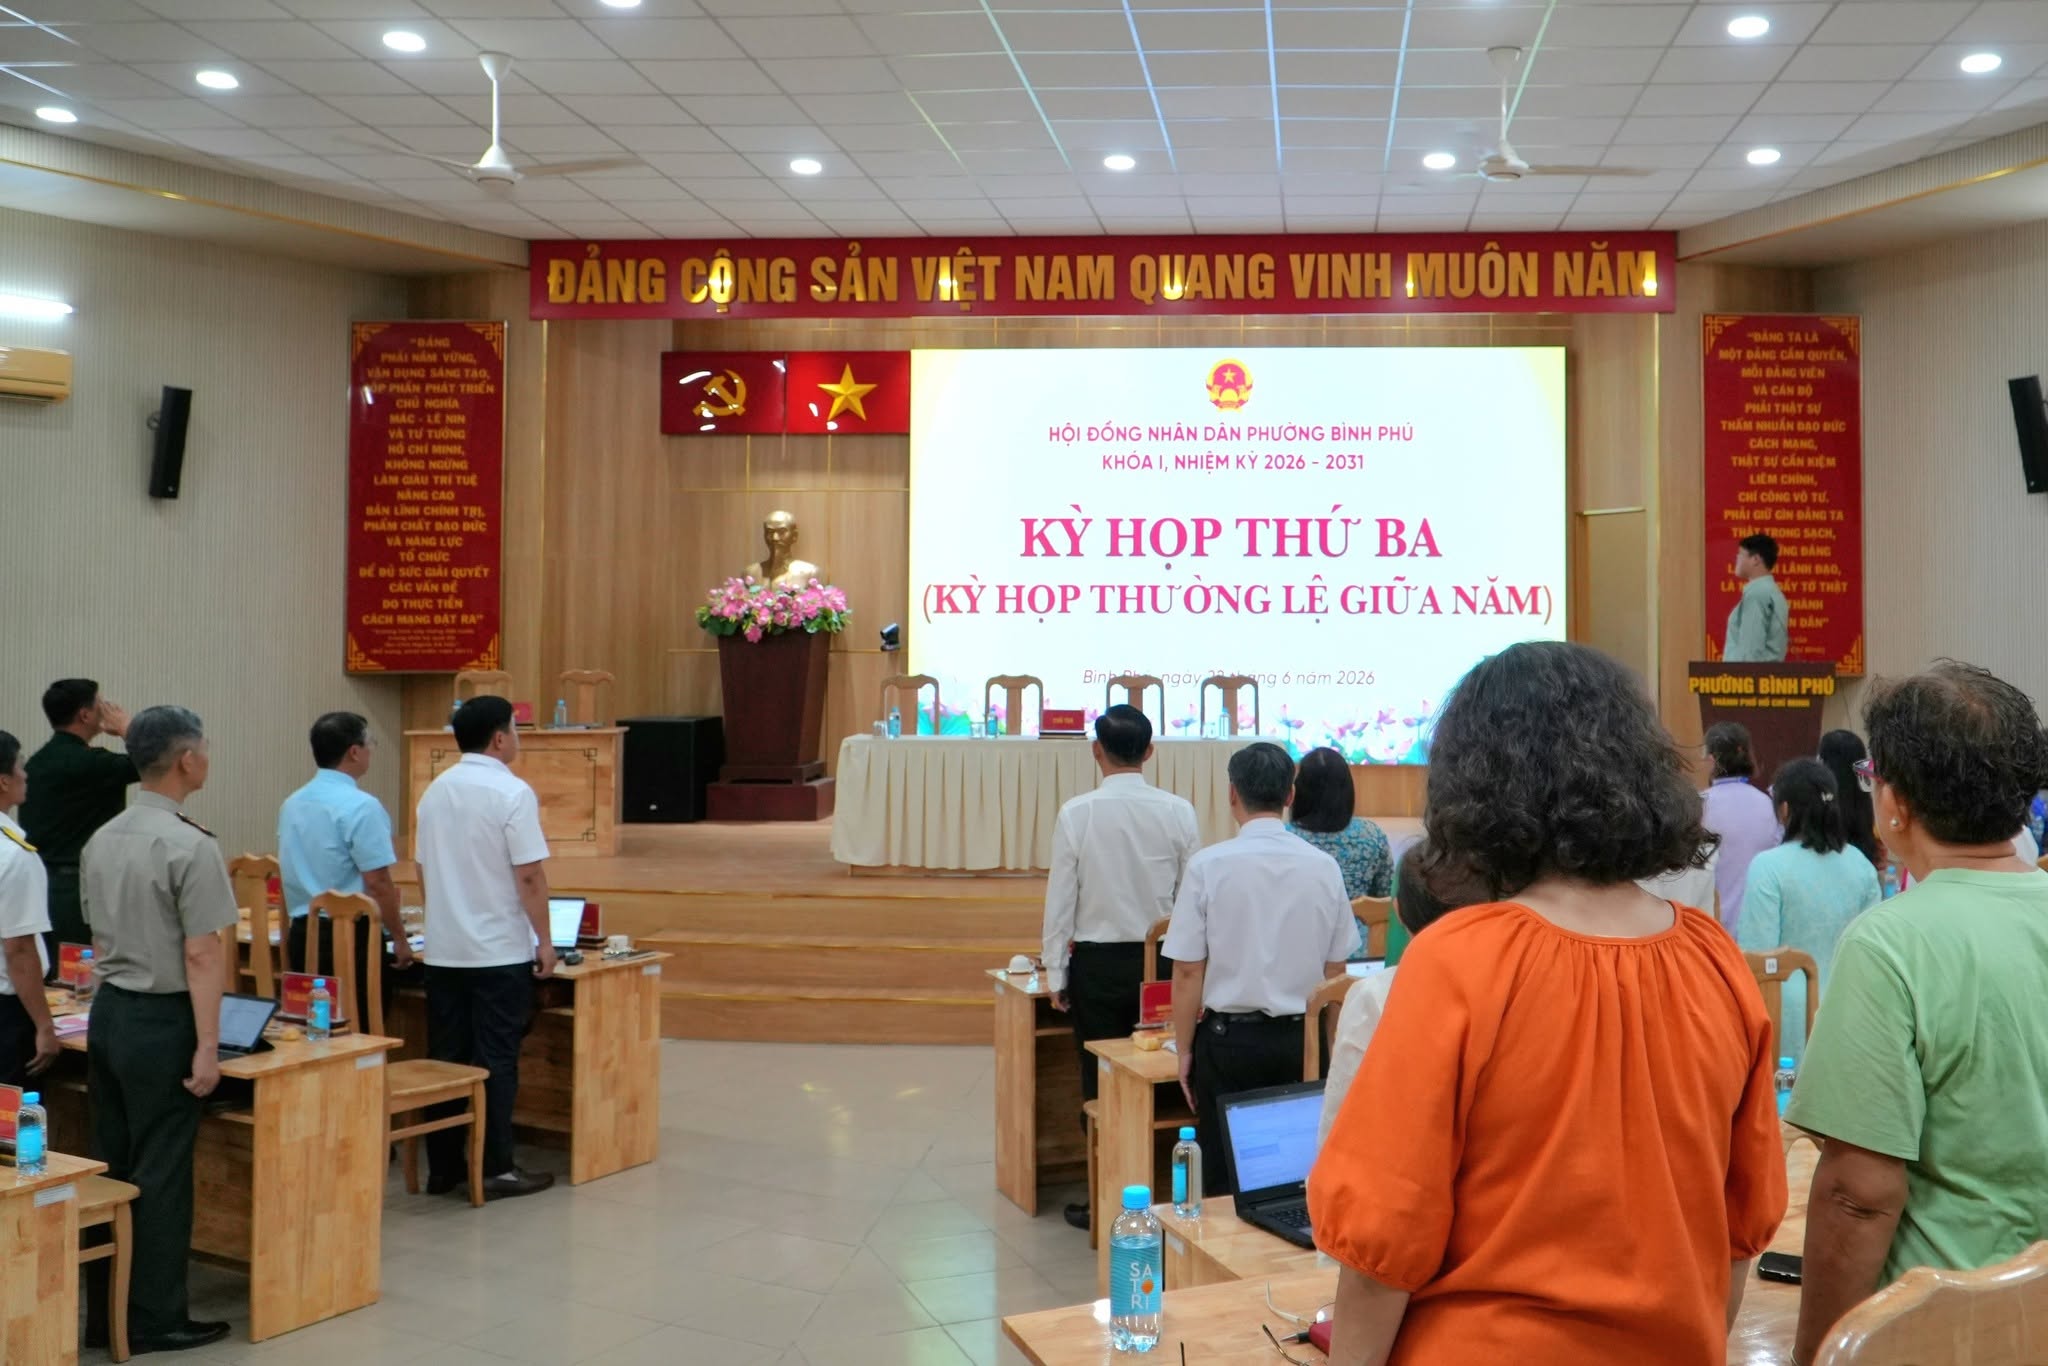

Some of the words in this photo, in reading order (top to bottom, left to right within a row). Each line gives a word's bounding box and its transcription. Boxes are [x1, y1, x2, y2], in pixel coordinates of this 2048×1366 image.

[547, 243, 666, 303] ĐẢNG
[681, 247, 797, 313] CỘNG
[810, 242, 898, 303] SẢN
[911, 246, 1001, 312] VIỆT
[1015, 254, 1115, 301] NAM
[1130, 253, 1275, 305] QUANG
[1289, 252, 1391, 299] VINH
[1406, 241, 1538, 298] MUÔN
[1553, 241, 1657, 297] NĂM
[1050, 422, 1080, 446] HỘI
[1087, 421, 1142, 442] ĐỒNG
[1148, 422, 1198, 441] NHÂN
[1204, 422, 1240, 441] DÂN
[1248, 422, 1325, 441] PHƯỜNG
[1331, 422, 1371, 441] BÌNH
[1378, 422, 1412, 441] PHÚ
[1103, 451, 1152, 470] KHÓA
[1160, 455, 1168, 472] I,
[1175, 451, 1229, 474] NHIỆM
[1236, 451, 1257, 469] KỲ
[1264, 454, 1306, 470] 2026
[1326, 454, 1363, 470] 2031
[1020, 504, 1092, 557] KỲ
[1106, 518, 1222, 570] HỌP
[1236, 504, 1360, 558] THỨ
[1376, 518, 1441, 557] BA
[923, 575, 986, 623] (KỲ
[996, 585, 1080, 623] HỌP
[1090, 575, 1270, 614] THƯỜNG
[1283, 574, 1328, 623] LỆ
[1340, 576, 1442, 614] GIỮA
[1453, 576, 1552, 624] NĂM)
[1281, 670, 1291, 685] 6
[1297, 668, 1332, 685] năm
[1336, 670, 1375, 685] 2026
[1689, 672, 1754, 694] PHƯỜNG
[1759, 675, 1798, 694] BÌNH
[1801, 674, 1834, 696] PHÚ
